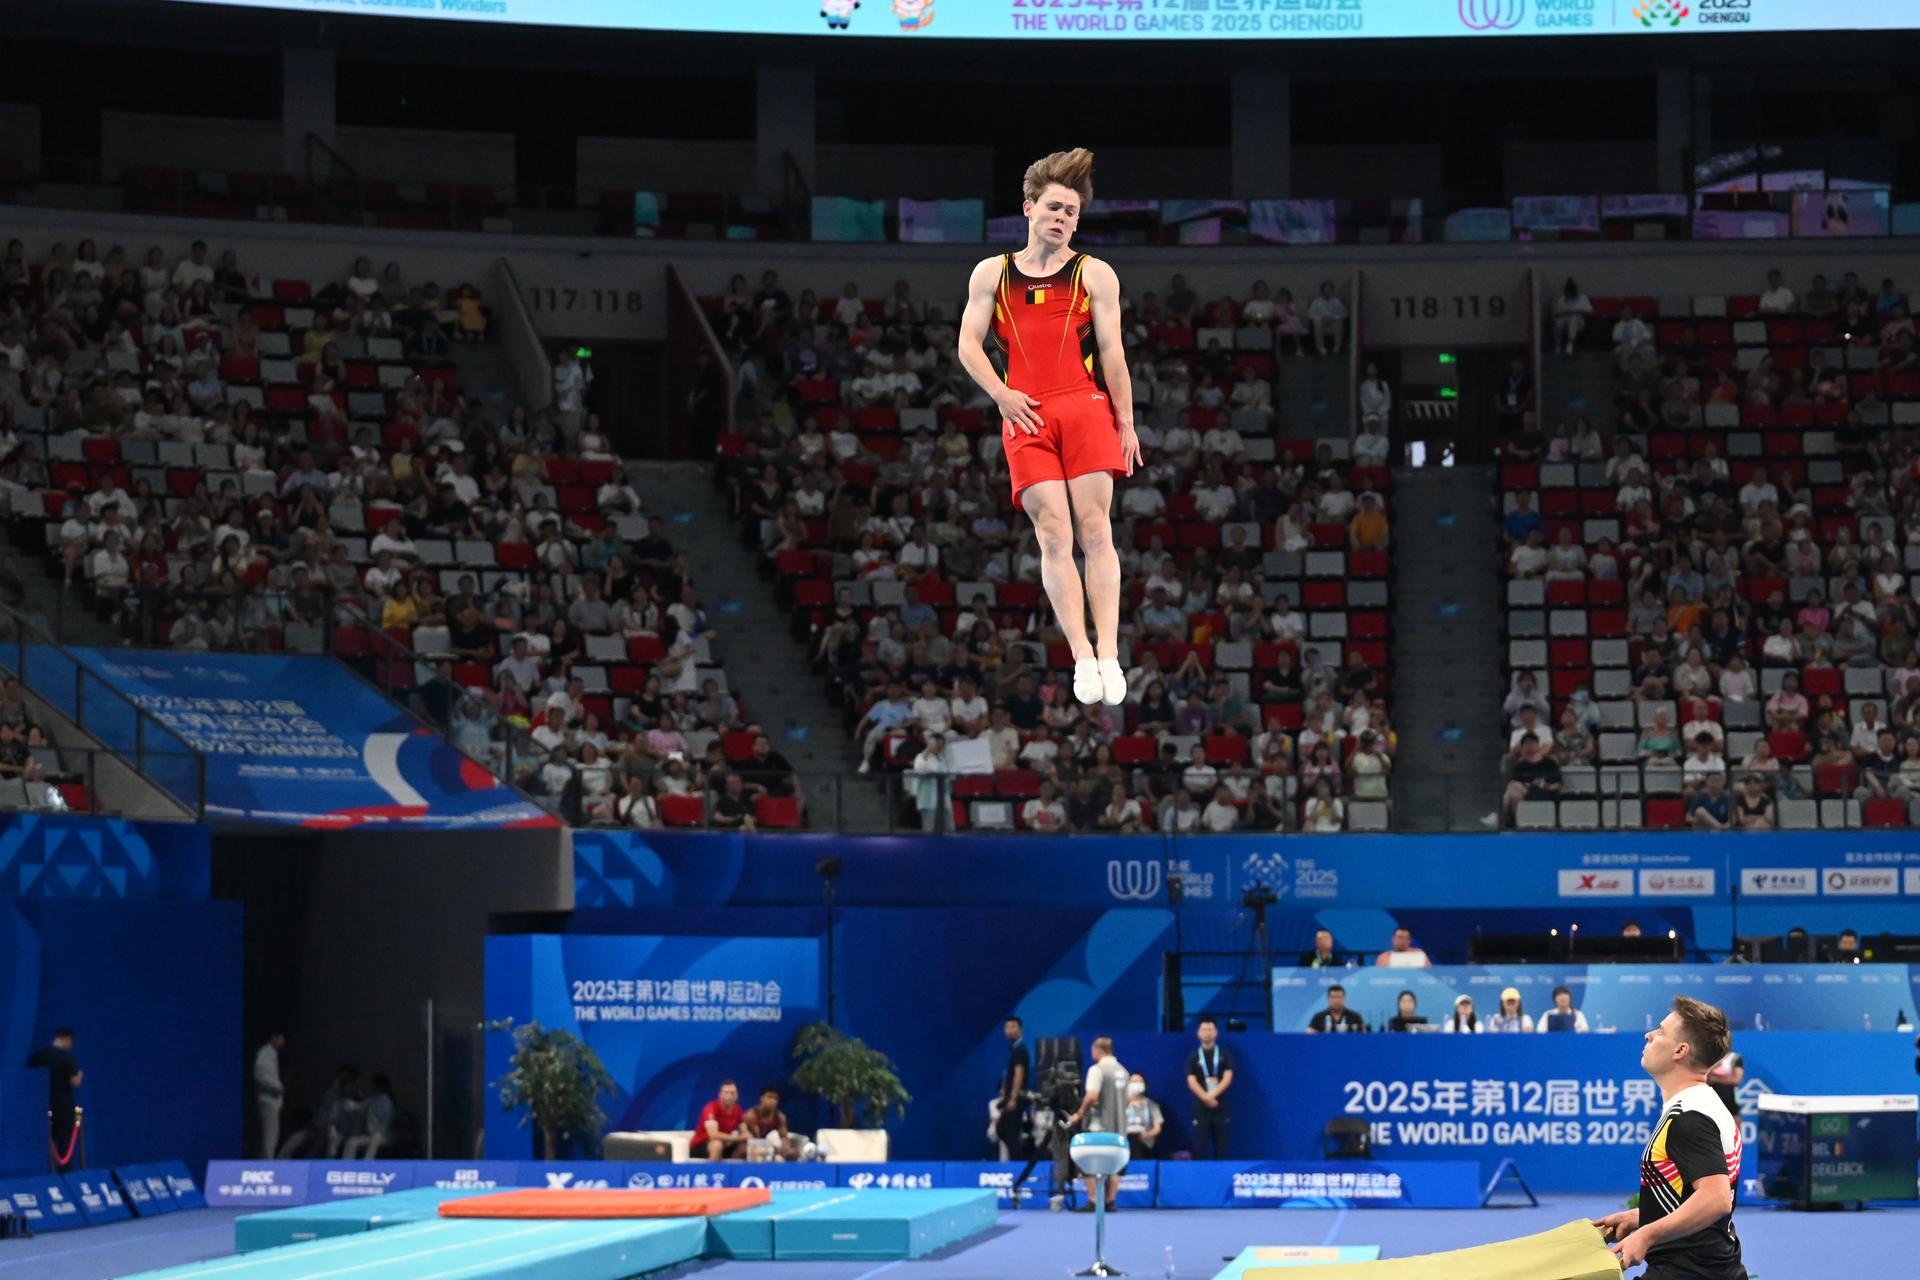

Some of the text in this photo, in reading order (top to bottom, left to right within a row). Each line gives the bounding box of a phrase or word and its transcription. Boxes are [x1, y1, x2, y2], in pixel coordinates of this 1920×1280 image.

[441, 0, 507, 14] Wonders
[1536, 0, 1594, 11] WORLD
[1011, 13, 1363, 31] THE WORLD GAMES 2025 CHENGDU
[1535, 13, 1594, 27] GAMES
[1699, 12, 1750, 23] CHENGDU
[1028, 283, 1052, 291] Quatro
[530, 287, 642, 312] 117 118
[1391, 295, 1505, 318] 118 119
[1296, 870, 1338, 885] 2025
[573, 979, 781, 1004] 2025年第12届世界运动会
[574, 1006, 782, 1022] THE WORLD GAMES 2025 CHENGDU
[1820, 1118, 1841, 1133] GO
[1360, 1122, 1651, 1146] HE WORLD GAMES 2025
[326, 1171, 396, 1185] GEELY
[1233, 1173, 1401, 1188] 2025年第12届世界运动会
